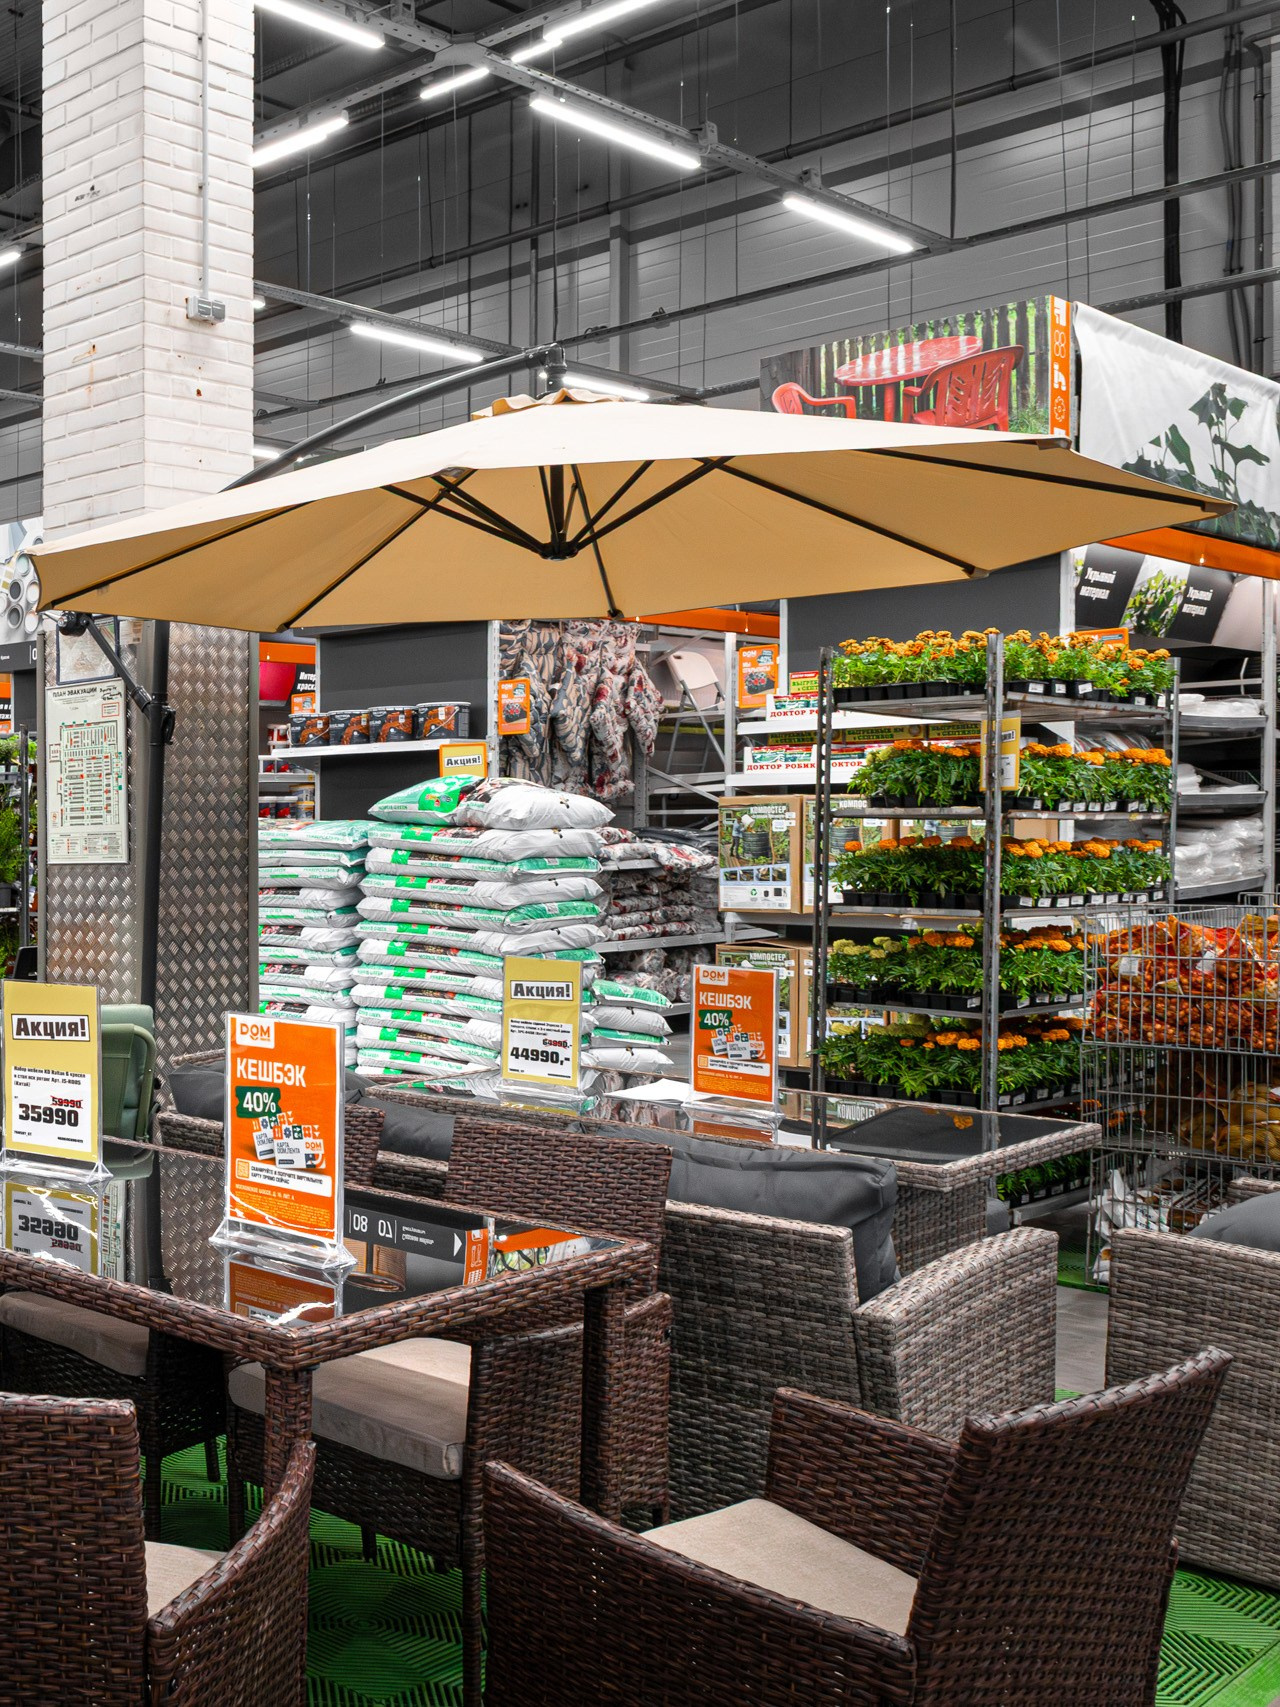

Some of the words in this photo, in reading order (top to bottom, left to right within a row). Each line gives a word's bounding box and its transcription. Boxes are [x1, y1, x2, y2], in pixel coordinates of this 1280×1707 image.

[52, 690, 66, 698] ПЛАН
[67, 687, 97, 697] ЭВАКУАЦИИ
[446, 755, 481, 767] Акция!
[750, 805, 787, 814] КОМПОСТЕР
[839, 800, 868, 808] КОМПОС
[749, 953, 786, 961] КОМПОСТЕР
[702, 970, 726, 979] DOM
[513, 983, 570, 998] Акция!
[699, 991, 752, 1010] КЕШБЭК
[704, 1012, 729, 1026] 40%
[16, 1018, 86, 1039] Акция!
[240, 1023, 270, 1040] DOM
[510, 1047, 570, 1065] 44990,-
[237, 1057, 306, 1087] КЕШБЭК
[243, 1091, 276, 1112] 40%
[18, 1103, 79, 1127] 35990
[305, 1141, 321, 1149] DOM
